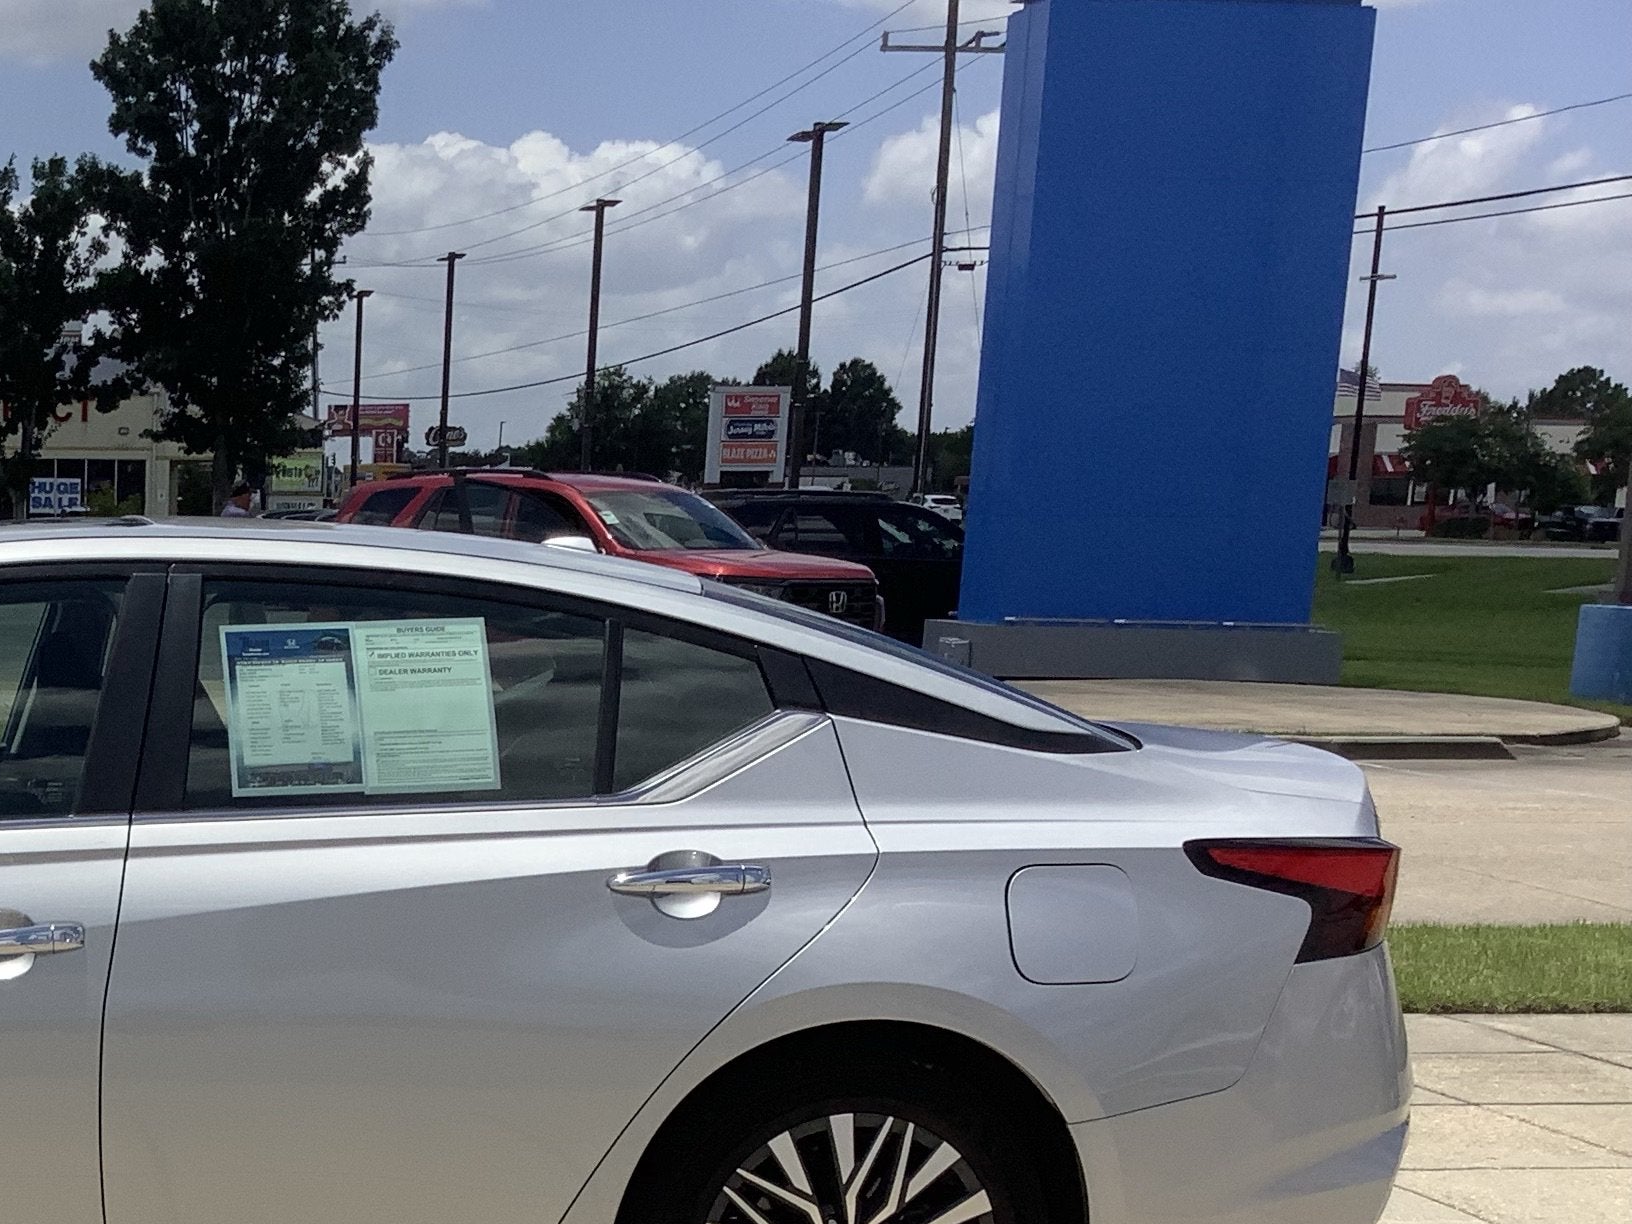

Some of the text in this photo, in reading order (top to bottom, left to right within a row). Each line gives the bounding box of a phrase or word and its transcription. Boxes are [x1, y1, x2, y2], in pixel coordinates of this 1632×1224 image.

[31, 481, 79, 494] HUGE
[408, 650, 457, 658] WARRANTIES
[458, 649, 479, 657] ONLY
